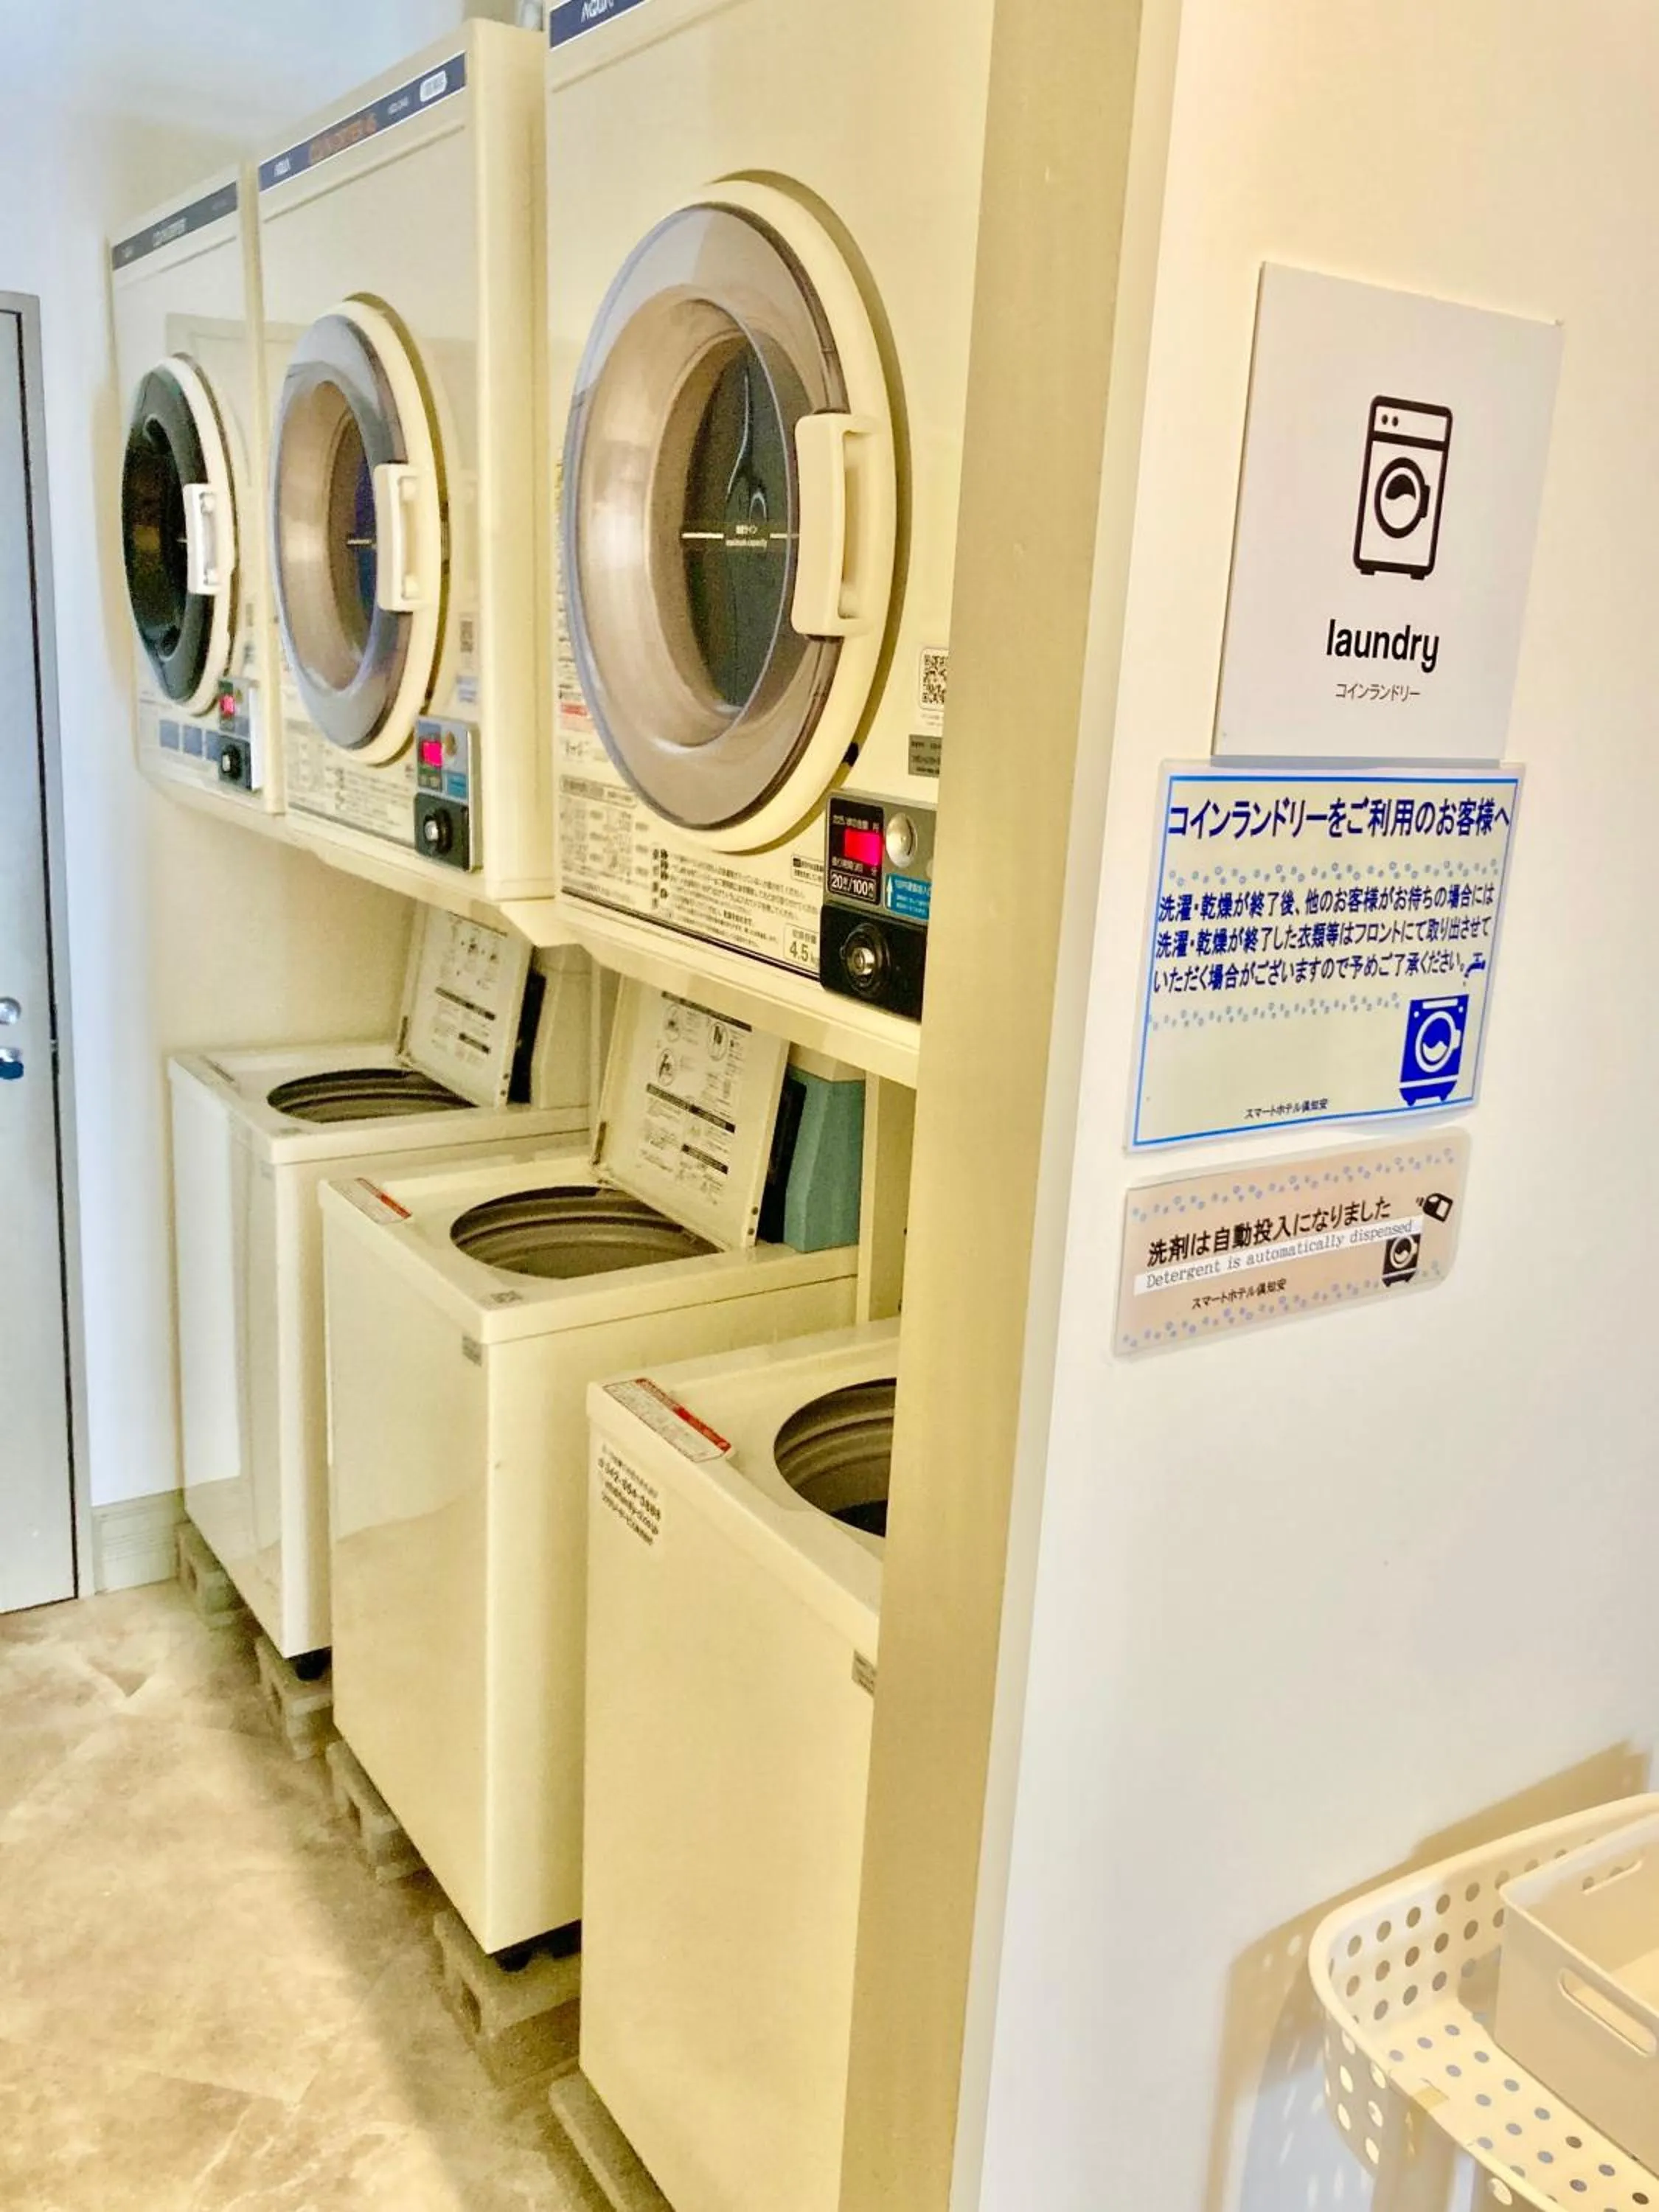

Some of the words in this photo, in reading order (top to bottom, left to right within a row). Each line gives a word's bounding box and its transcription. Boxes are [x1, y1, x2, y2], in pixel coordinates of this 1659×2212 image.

[1326, 619, 1439, 673] laundry
[1335, 683, 1420, 701] コインランドリー
[1168, 797, 1509, 839] コインランドリーをご利用のお客様へ
[1158, 883, 1494, 922] 洗濯・乾燥が終了後、他のお客様がお待ちの場合には
[1155, 917, 1492, 959] 洗濯・乾燥が終了した衣類等はフロントにて取り出させて
[1153, 951, 1465, 993] いただく場合がございますので予めご了承ください。
[1148, 1197, 1391, 1267] 洗剤は自動投入になりました
[1147, 1262, 1221, 1289] Detergent
[1227, 1256, 1241, 1270] is
[1246, 1234, 1344, 1266] automatically
[1350, 1220, 1412, 1245] dispensed
